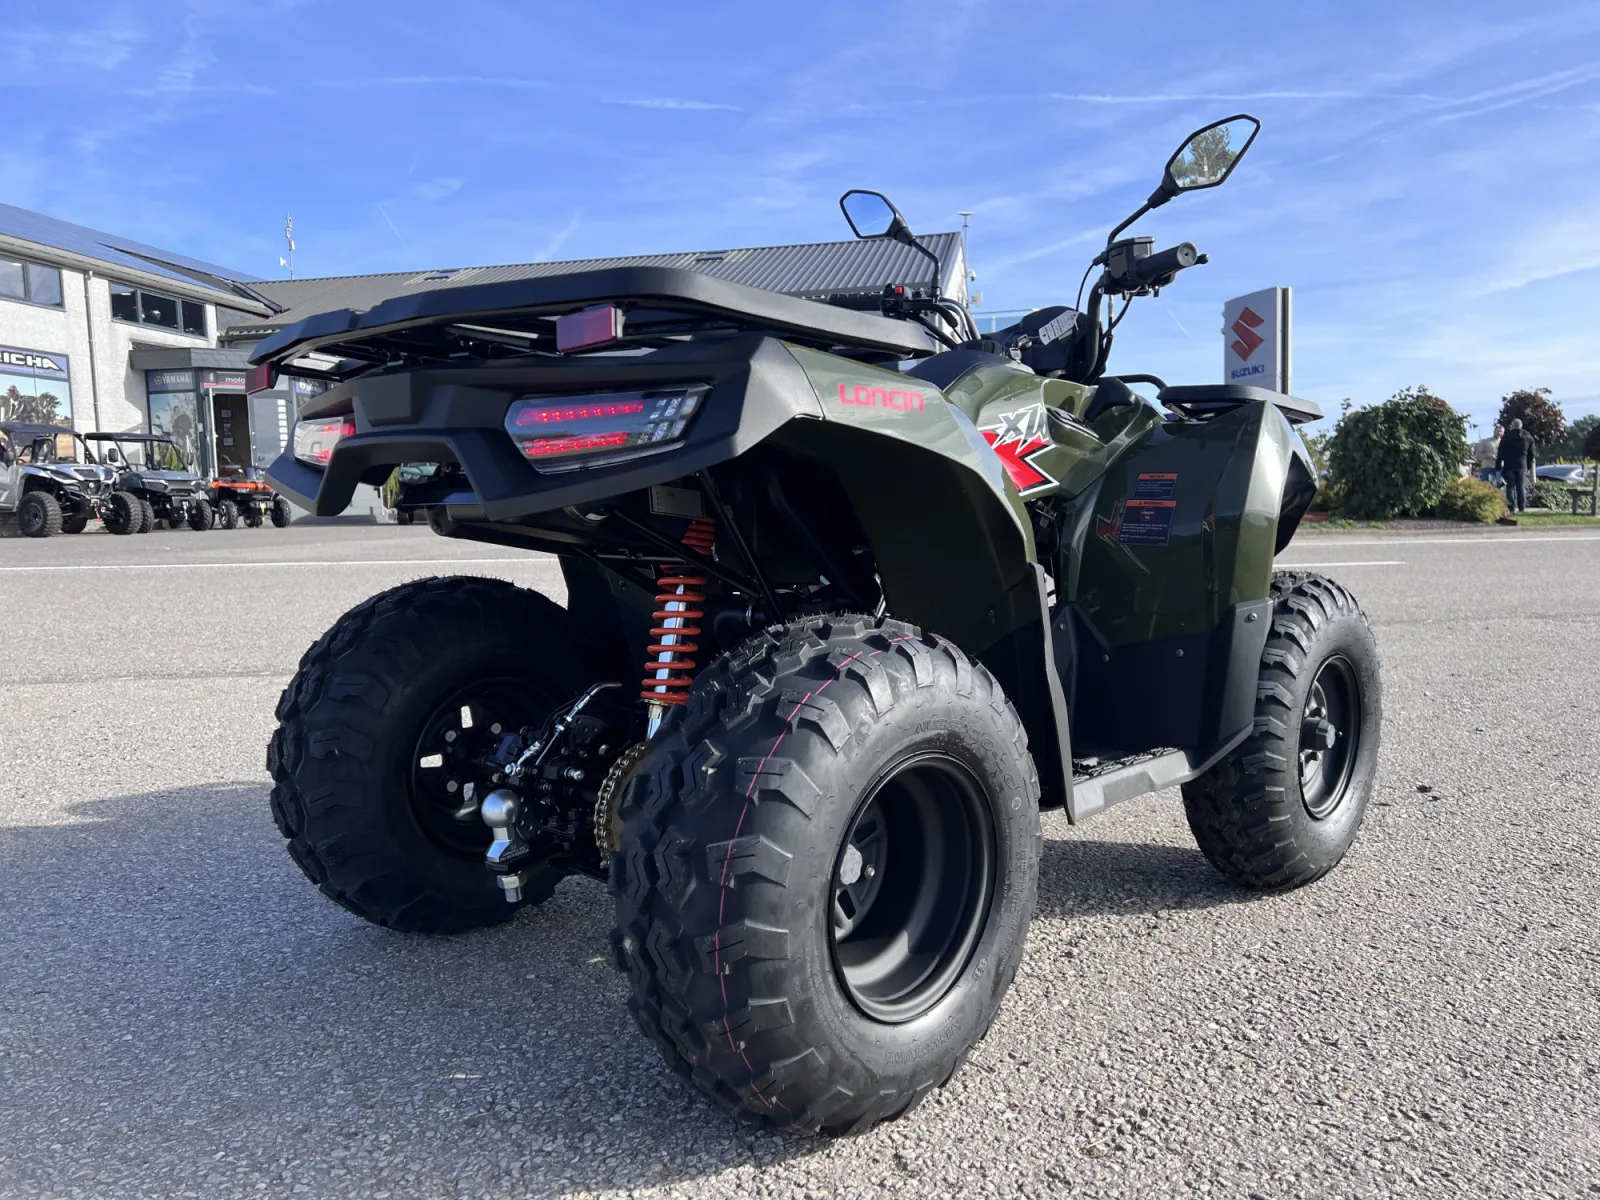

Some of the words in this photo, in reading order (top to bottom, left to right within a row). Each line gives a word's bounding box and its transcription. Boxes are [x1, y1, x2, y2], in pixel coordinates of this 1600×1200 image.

[0, 351, 61, 371] ICHA
[162, 375, 190, 385] YAMAHA
[1231, 364, 1265, 379] SUZUKI
[838, 383, 924, 412] LONCIN
